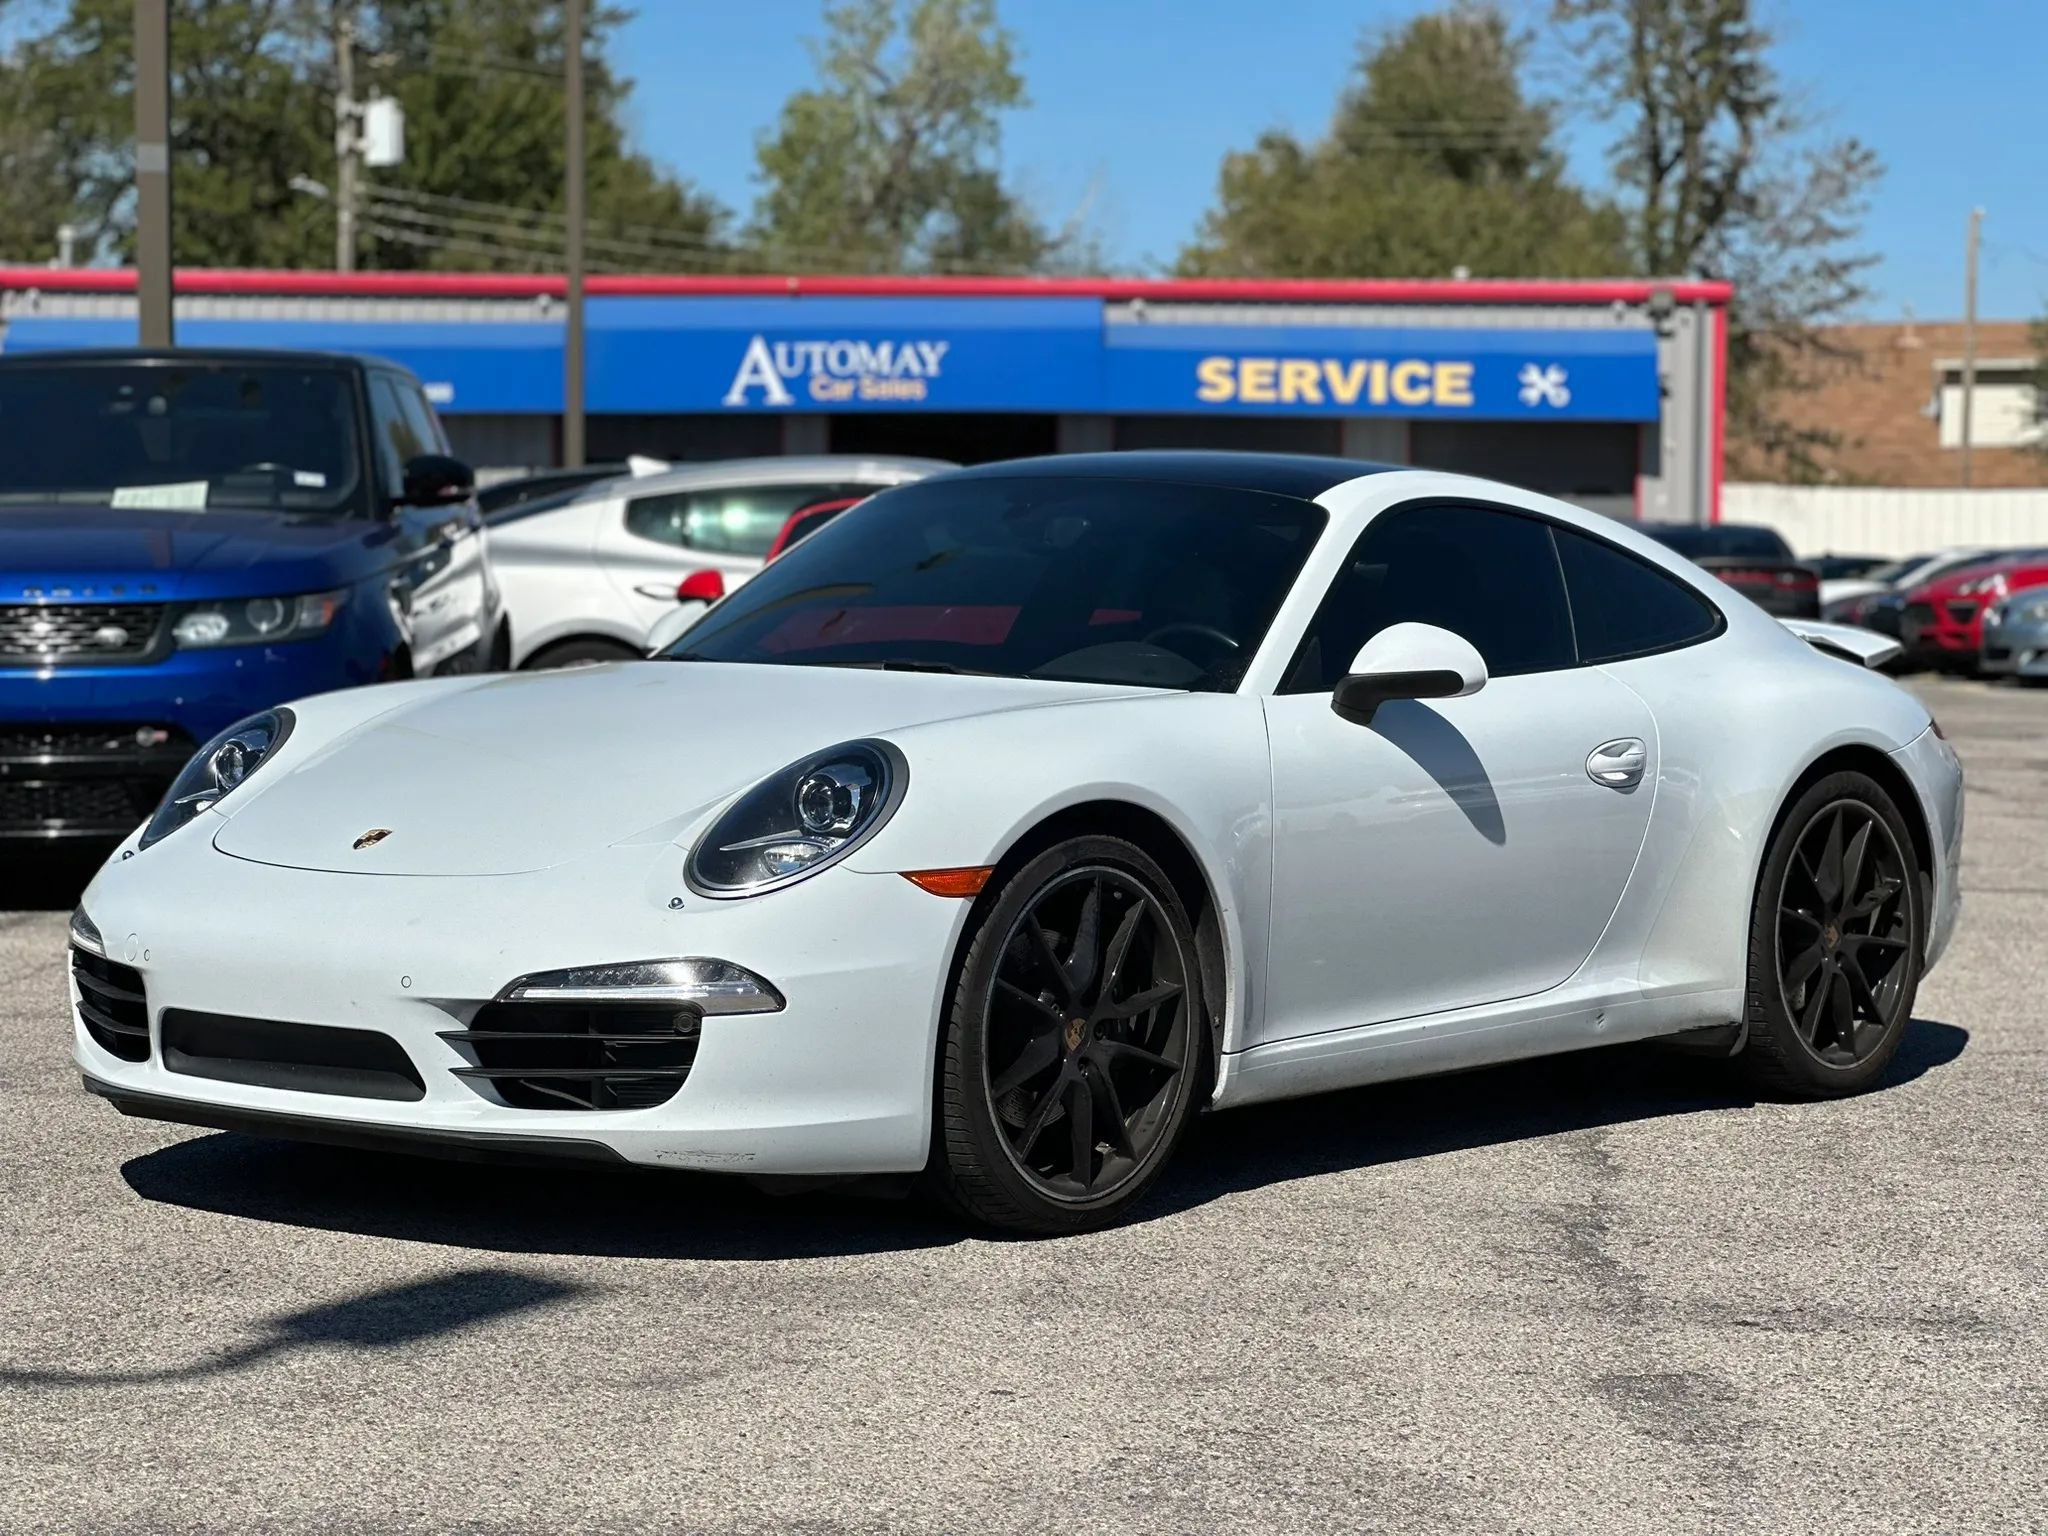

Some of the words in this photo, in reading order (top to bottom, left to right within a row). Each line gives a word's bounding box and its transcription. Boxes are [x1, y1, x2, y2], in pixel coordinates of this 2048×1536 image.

[722, 334, 949, 406] AUTOMAY
[809, 374, 853, 401] Car
[1197, 357, 1474, 406] SERVICE
